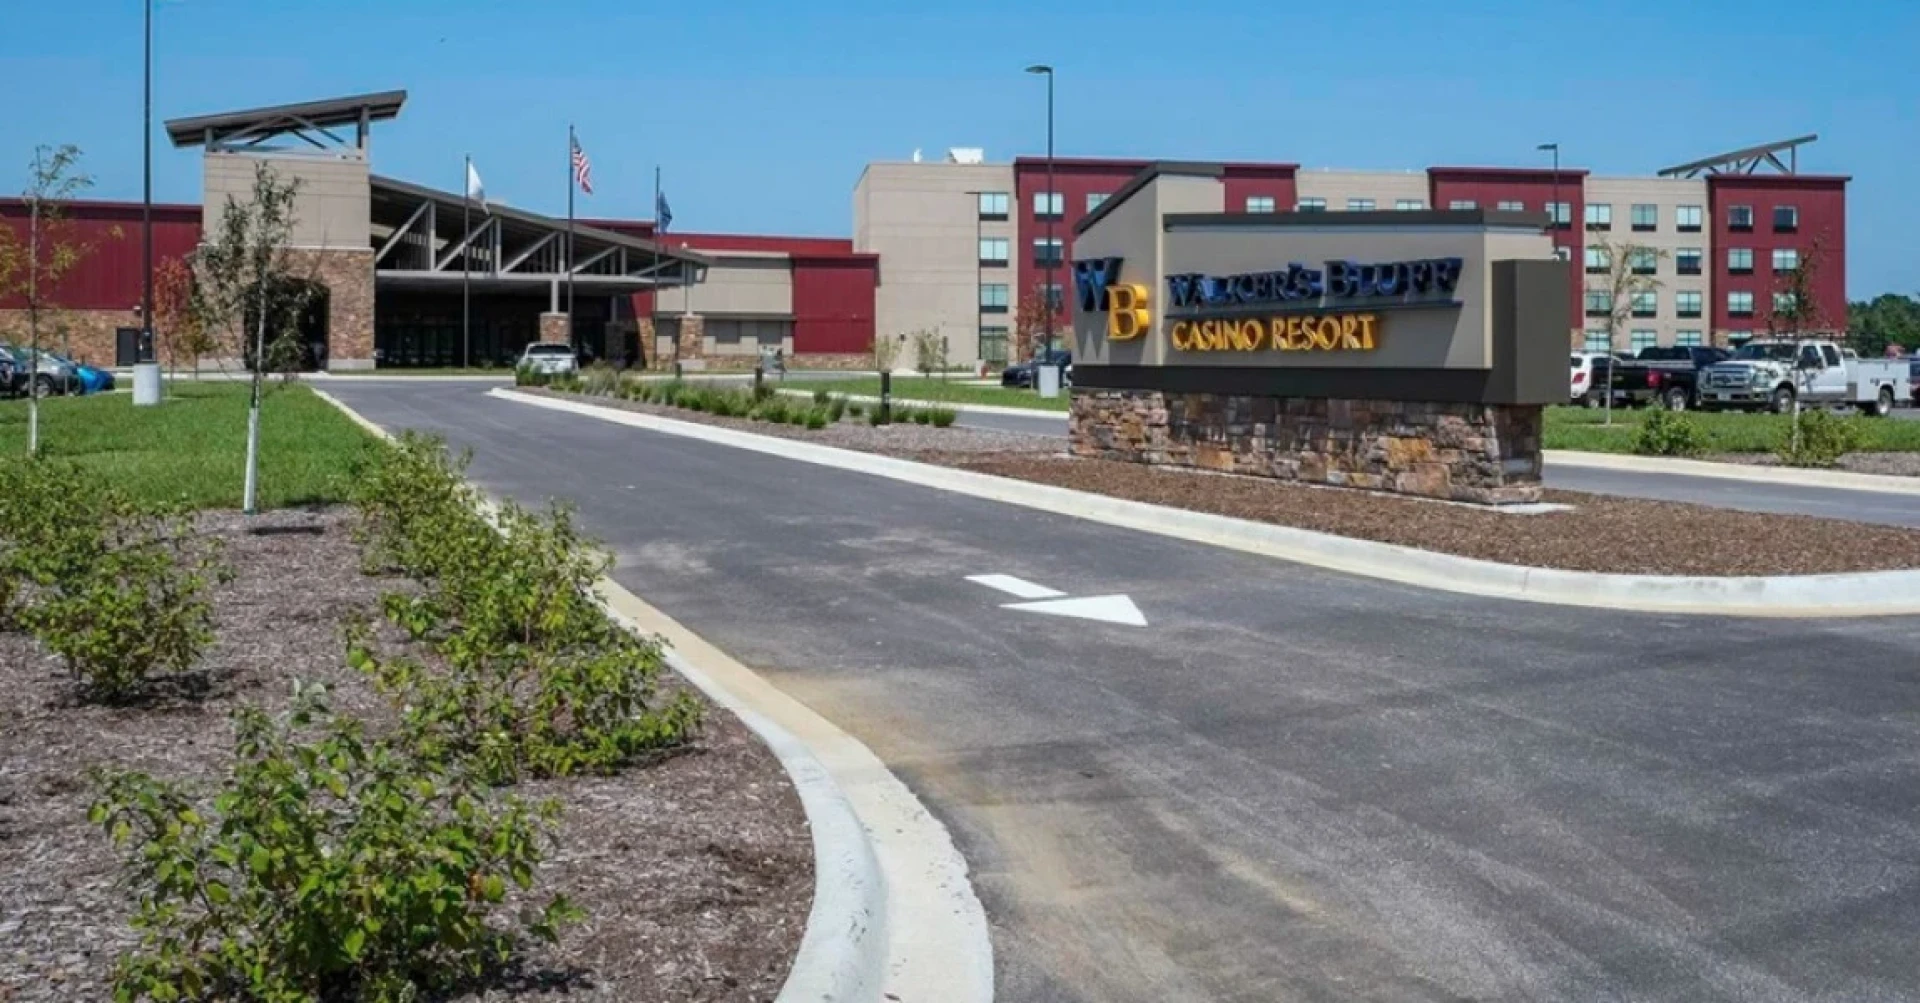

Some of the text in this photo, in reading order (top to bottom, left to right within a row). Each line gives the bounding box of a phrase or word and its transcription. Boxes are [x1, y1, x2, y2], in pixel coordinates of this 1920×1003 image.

[1165, 258, 1463, 306] WALKER'S BLUFF
[1171, 315, 1377, 351] CASINO RESORT
